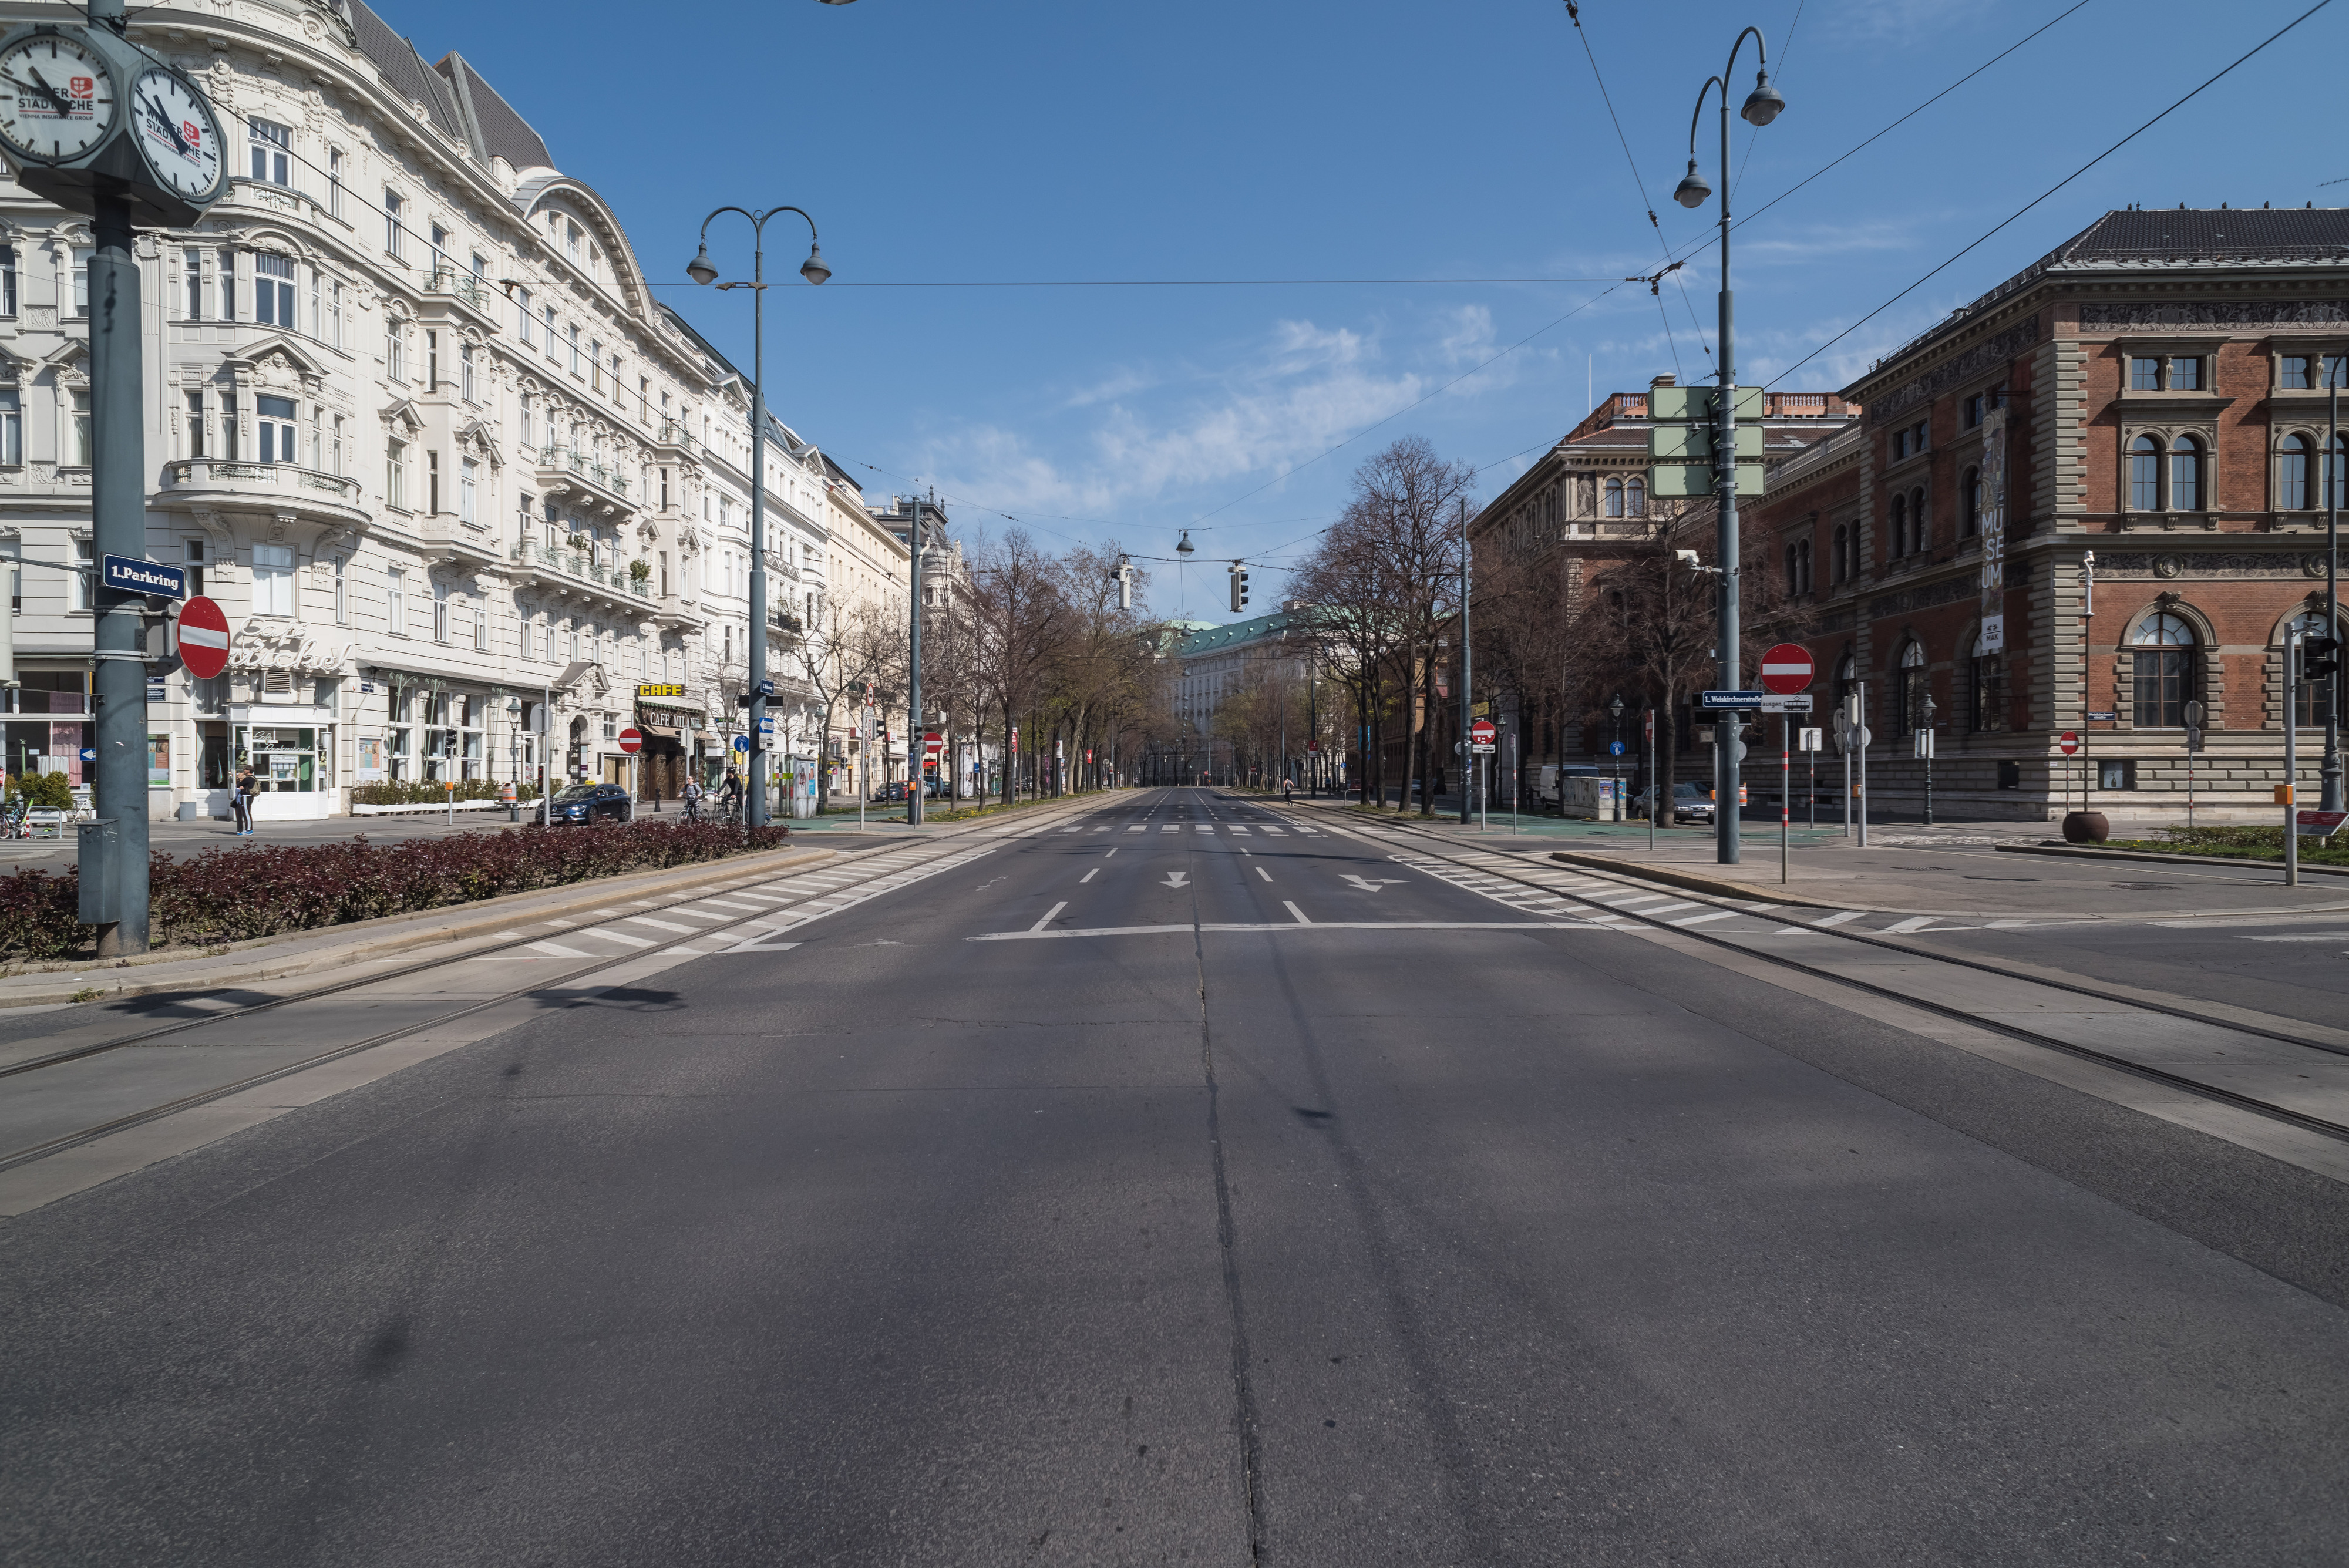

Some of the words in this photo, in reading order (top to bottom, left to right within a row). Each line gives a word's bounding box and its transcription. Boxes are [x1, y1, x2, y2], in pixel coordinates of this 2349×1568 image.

[147, 133, 164, 146] VIENNA
[163, 143, 186, 160] INSURANCE
[187, 157, 201, 168] GROUP
[1982, 508, 2003, 536] MU
[1985, 535, 2004, 561] SE
[123, 567, 179, 590] Parkring
[1982, 562, 2002, 588] UM
[240, 616, 311, 647] Café
[1986, 633, 1998, 641] MAK
[640, 685, 682, 696] CAFE
[673, 715, 696, 728] MILAN
